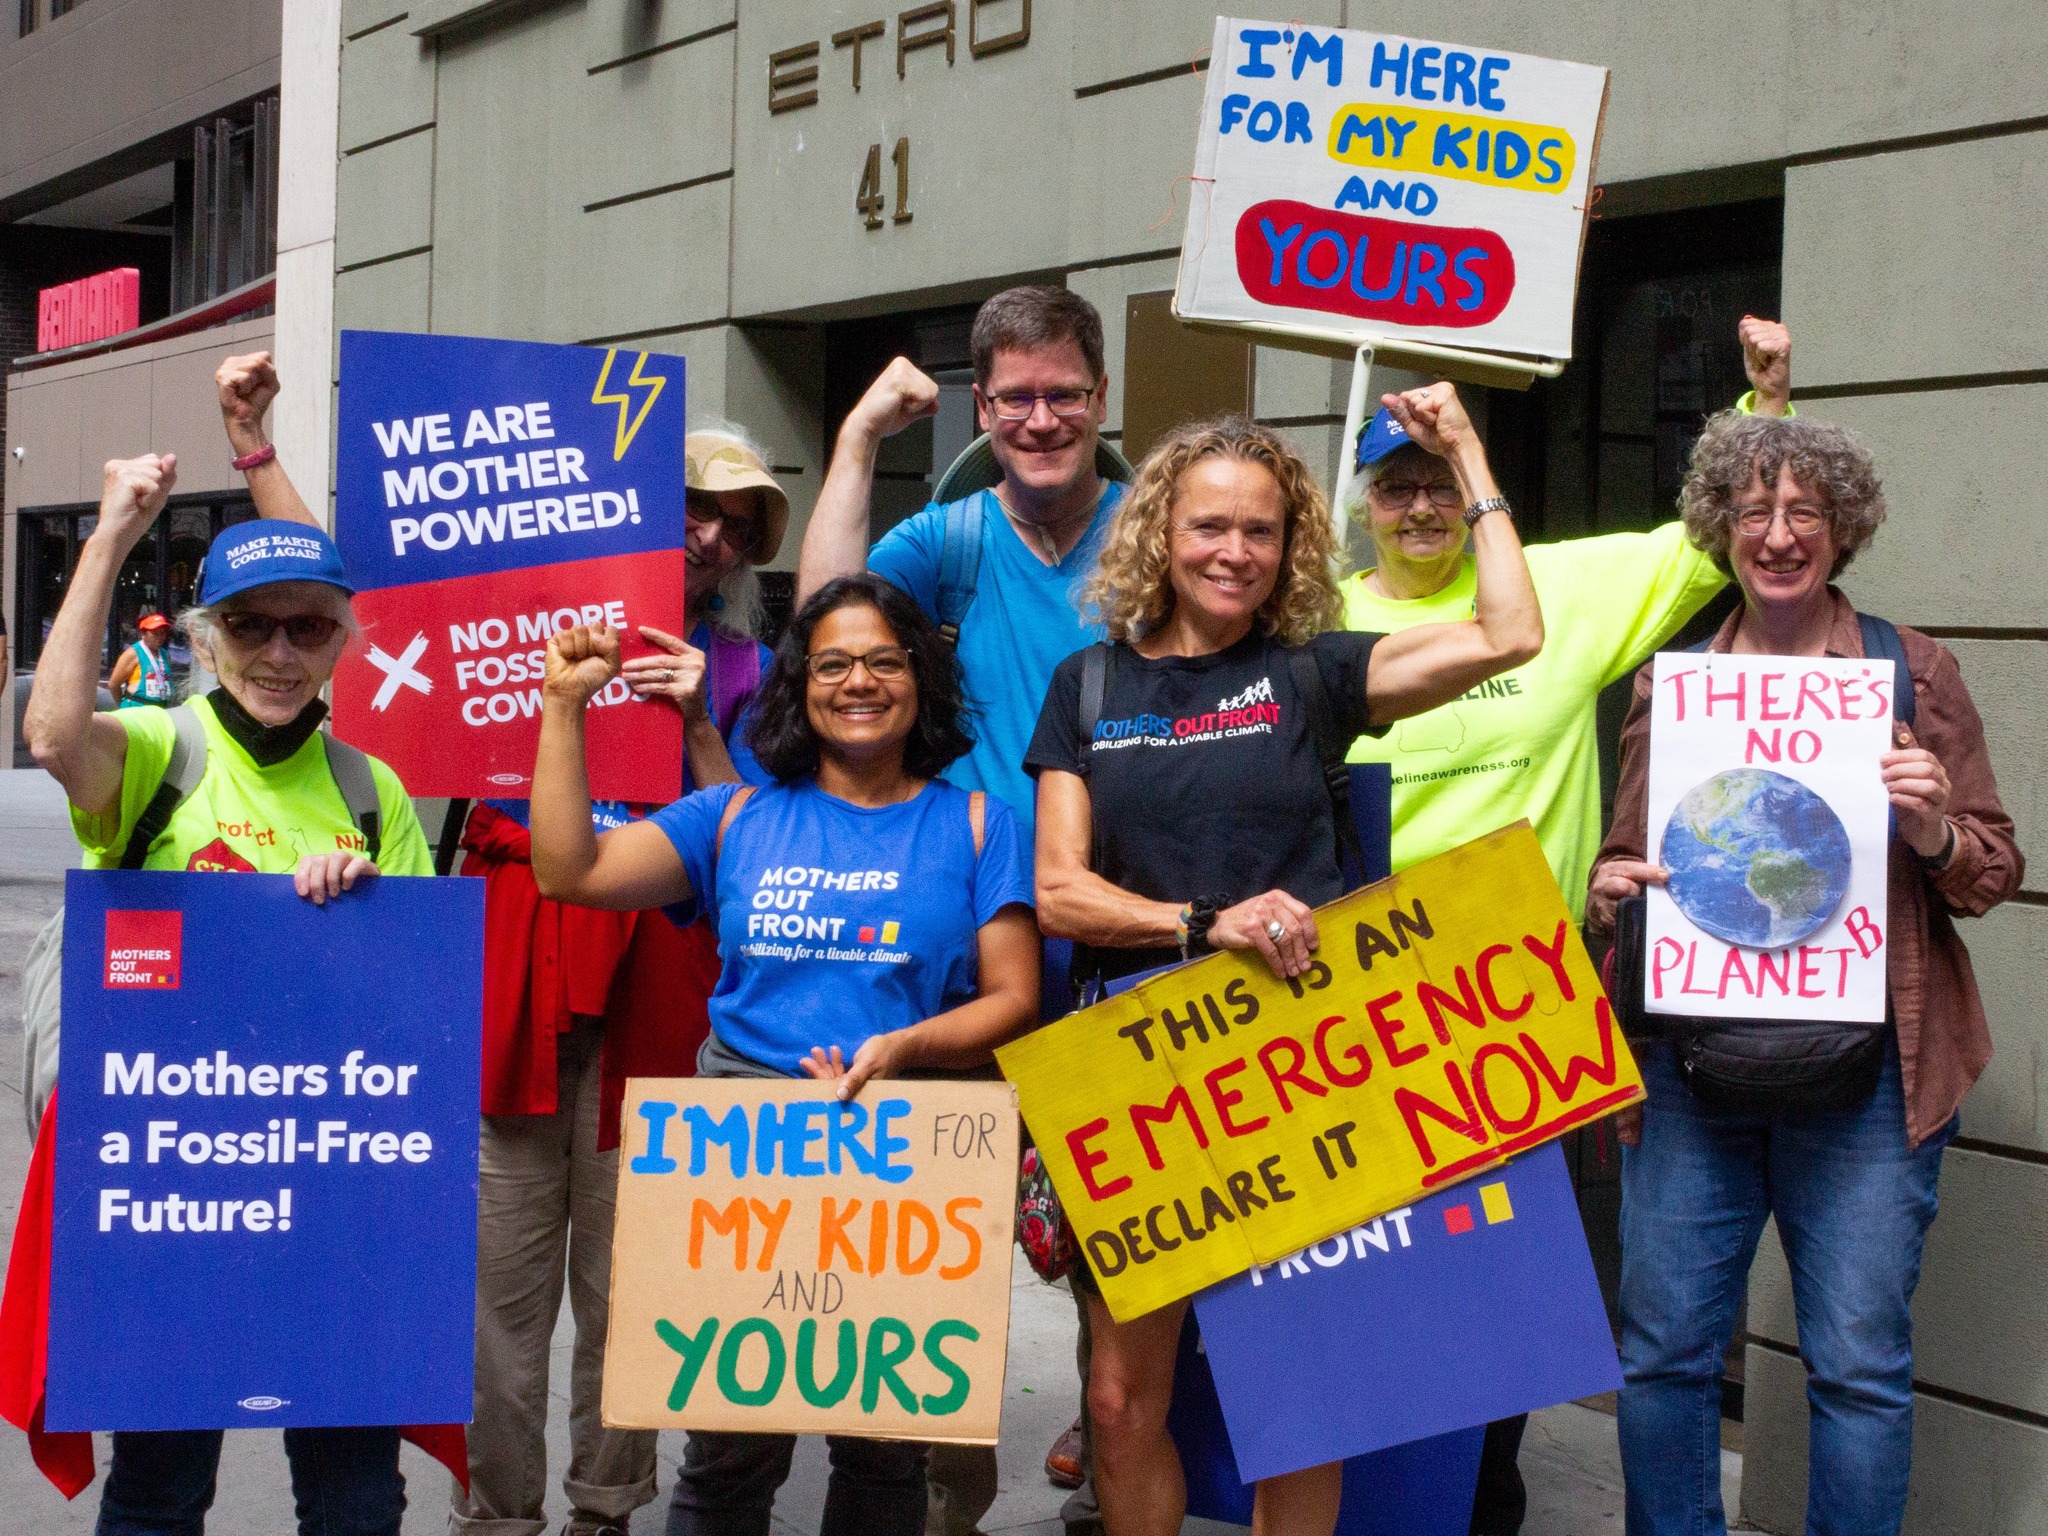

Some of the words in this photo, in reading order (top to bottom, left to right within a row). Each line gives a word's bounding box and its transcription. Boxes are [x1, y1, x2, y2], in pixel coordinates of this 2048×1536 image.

[1237, 29, 1343, 87] I'M
[1370, 42, 1510, 111] HERE
[1219, 94, 1313, 144] FOR
[1336, 114, 1417, 158] MY
[1432, 123, 1563, 184] KIDS
[856, 136, 913, 230] 41
[1334, 175, 1438, 216] AND
[1260, 217, 1489, 311] YOURS
[371, 413, 455, 458] WE
[462, 402, 555, 448] ARE
[383, 447, 590, 507] MOTHER
[390, 488, 642, 556] POWERED!
[226, 536, 269, 561] MAKE
[271, 535, 322, 551] EARTH
[231, 547, 271, 569] COOL
[274, 547, 321, 560] AGAIN
[449, 618, 510, 653] NO
[515, 601, 628, 643] MORE
[455, 653, 546, 690] FOSS
[1455, 678, 1523, 701] LINE
[1663, 668, 1892, 721] THERE'S
[462, 675, 650, 727] COWD
[1174, 713, 1217, 737] OUT
[1218, 703, 1281, 729] FRONT
[1092, 736, 1141, 751] OBILIZING
[1144, 736, 1167, 746] FOR
[1168, 738, 1178, 746] A
[1180, 731, 1223, 745] LIVABLE
[1225, 723, 1272, 737] CLIMATE
[1744, 728, 1823, 764] NO
[335, 834, 366, 851] NH
[752, 889, 814, 911] OUT
[758, 866, 899, 891] MOTHERS
[748, 913, 846, 941] FRONT
[110, 950, 171, 961] MOTHERS
[110, 961, 137, 972] OUT
[791, 943, 813, 961] for
[815, 949, 825, 960] a
[827, 947, 867, 961] livable
[1652, 936, 1856, 999] PLANET
[1843, 905, 1884, 959] B
[109, 972, 152, 984] FRONT
[1117, 977, 1260, 1062] THIS
[1286, 960, 1332, 999] IS
[1355, 899, 1434, 971] AN
[103, 1051, 328, 1096] Mothers
[340, 1050, 418, 1096] for
[1065, 919, 1575, 1202] EMERGENCY
[1394, 996, 1617, 1168] NOW
[100, 1131, 130, 1164] a
[147, 1118, 432, 1164] Fossil-Free
[934, 1112, 997, 1159] FOR
[100, 1188, 292, 1233] Future!
[1086, 1154, 1295, 1278] DECLARE
[1313, 1121, 1357, 1179] IT
[687, 1196, 792, 1272] MY
[818, 1196, 983, 1280] KIDS
[762, 1270, 844, 1315] AND
[654, 1316, 981, 1416] YOURS
